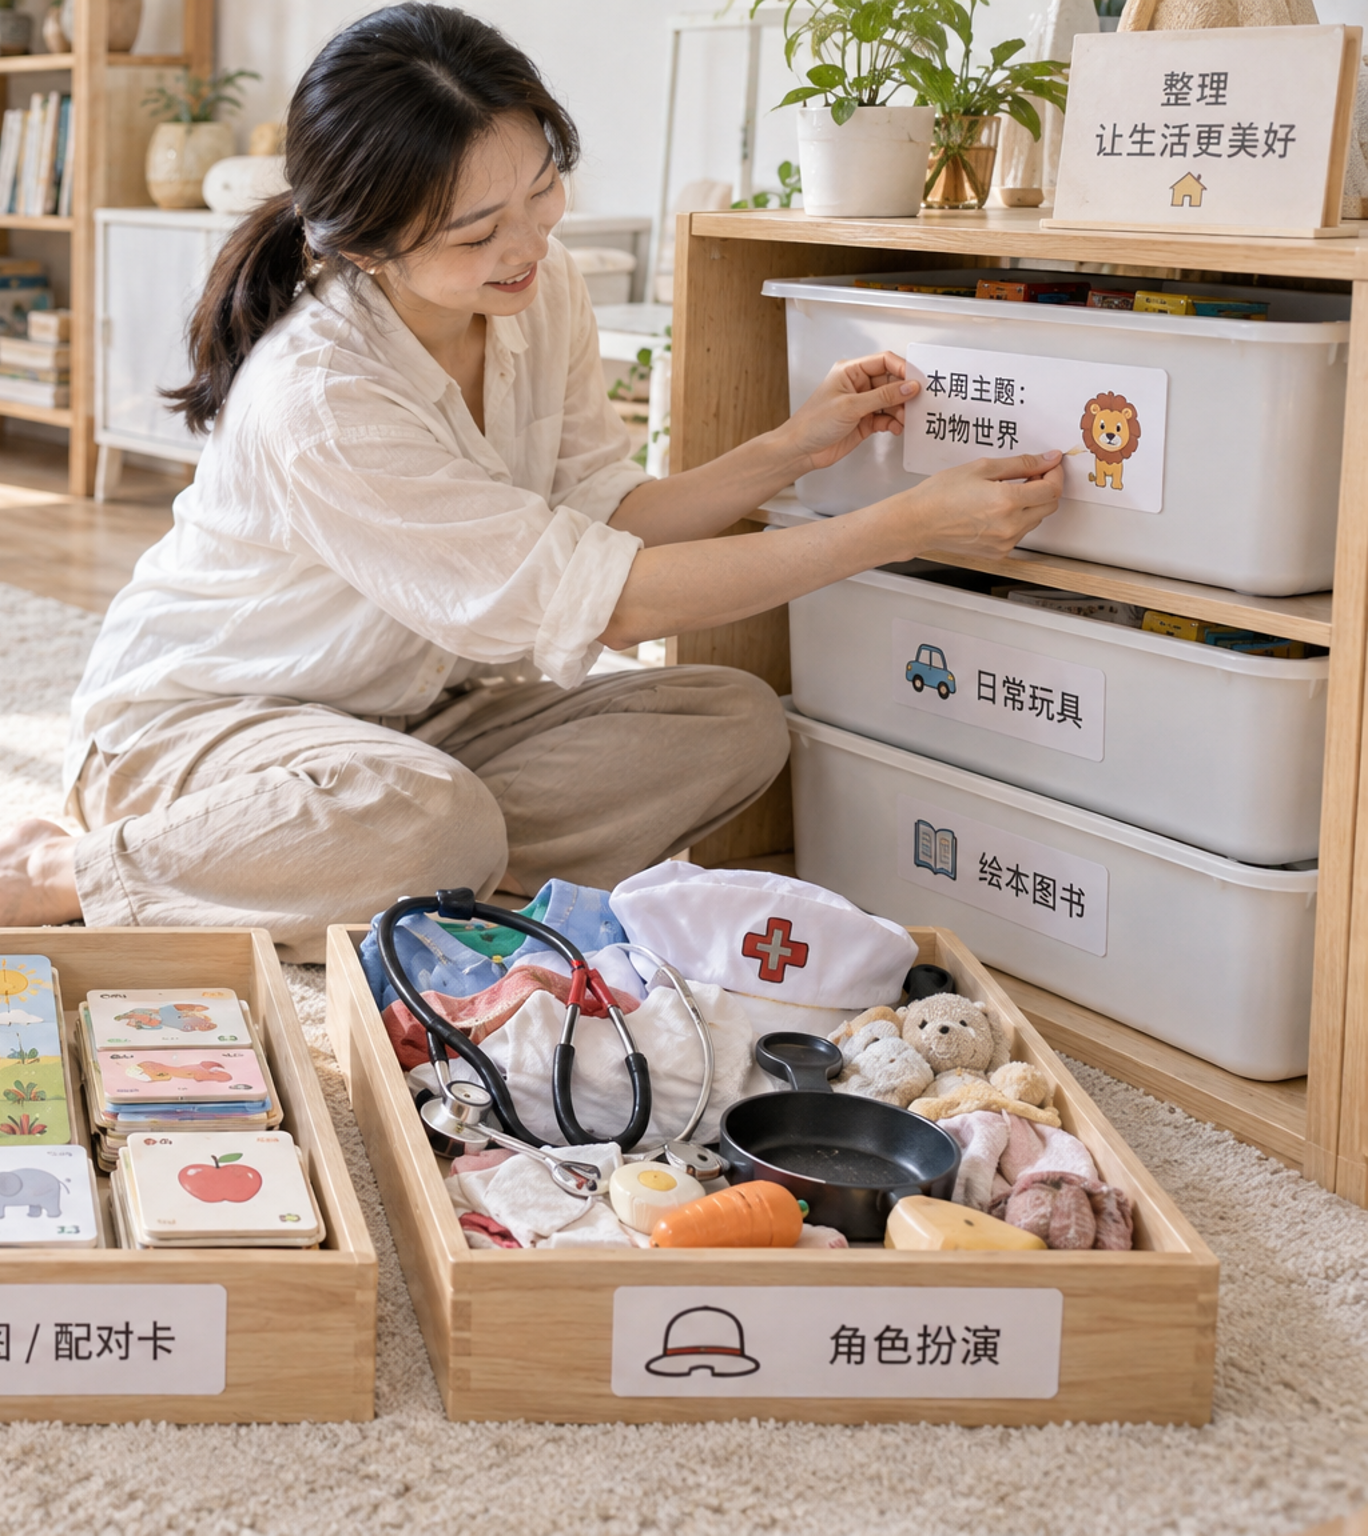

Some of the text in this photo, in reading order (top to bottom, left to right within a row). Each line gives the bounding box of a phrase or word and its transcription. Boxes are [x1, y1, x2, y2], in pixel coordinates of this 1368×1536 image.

[1160, 71, 1229, 107] 整理
[1095, 121, 1297, 159] 让生活更美好
[925, 411, 1019, 450] 动物世界
[977, 669, 1083, 729] 日常玩具
[978, 851, 1086, 918] 绘本图书
[25, 1322, 42, 1364] /
[54, 1320, 176, 1362] 配对卡
[829, 1324, 1001, 1367] 角色扮演
